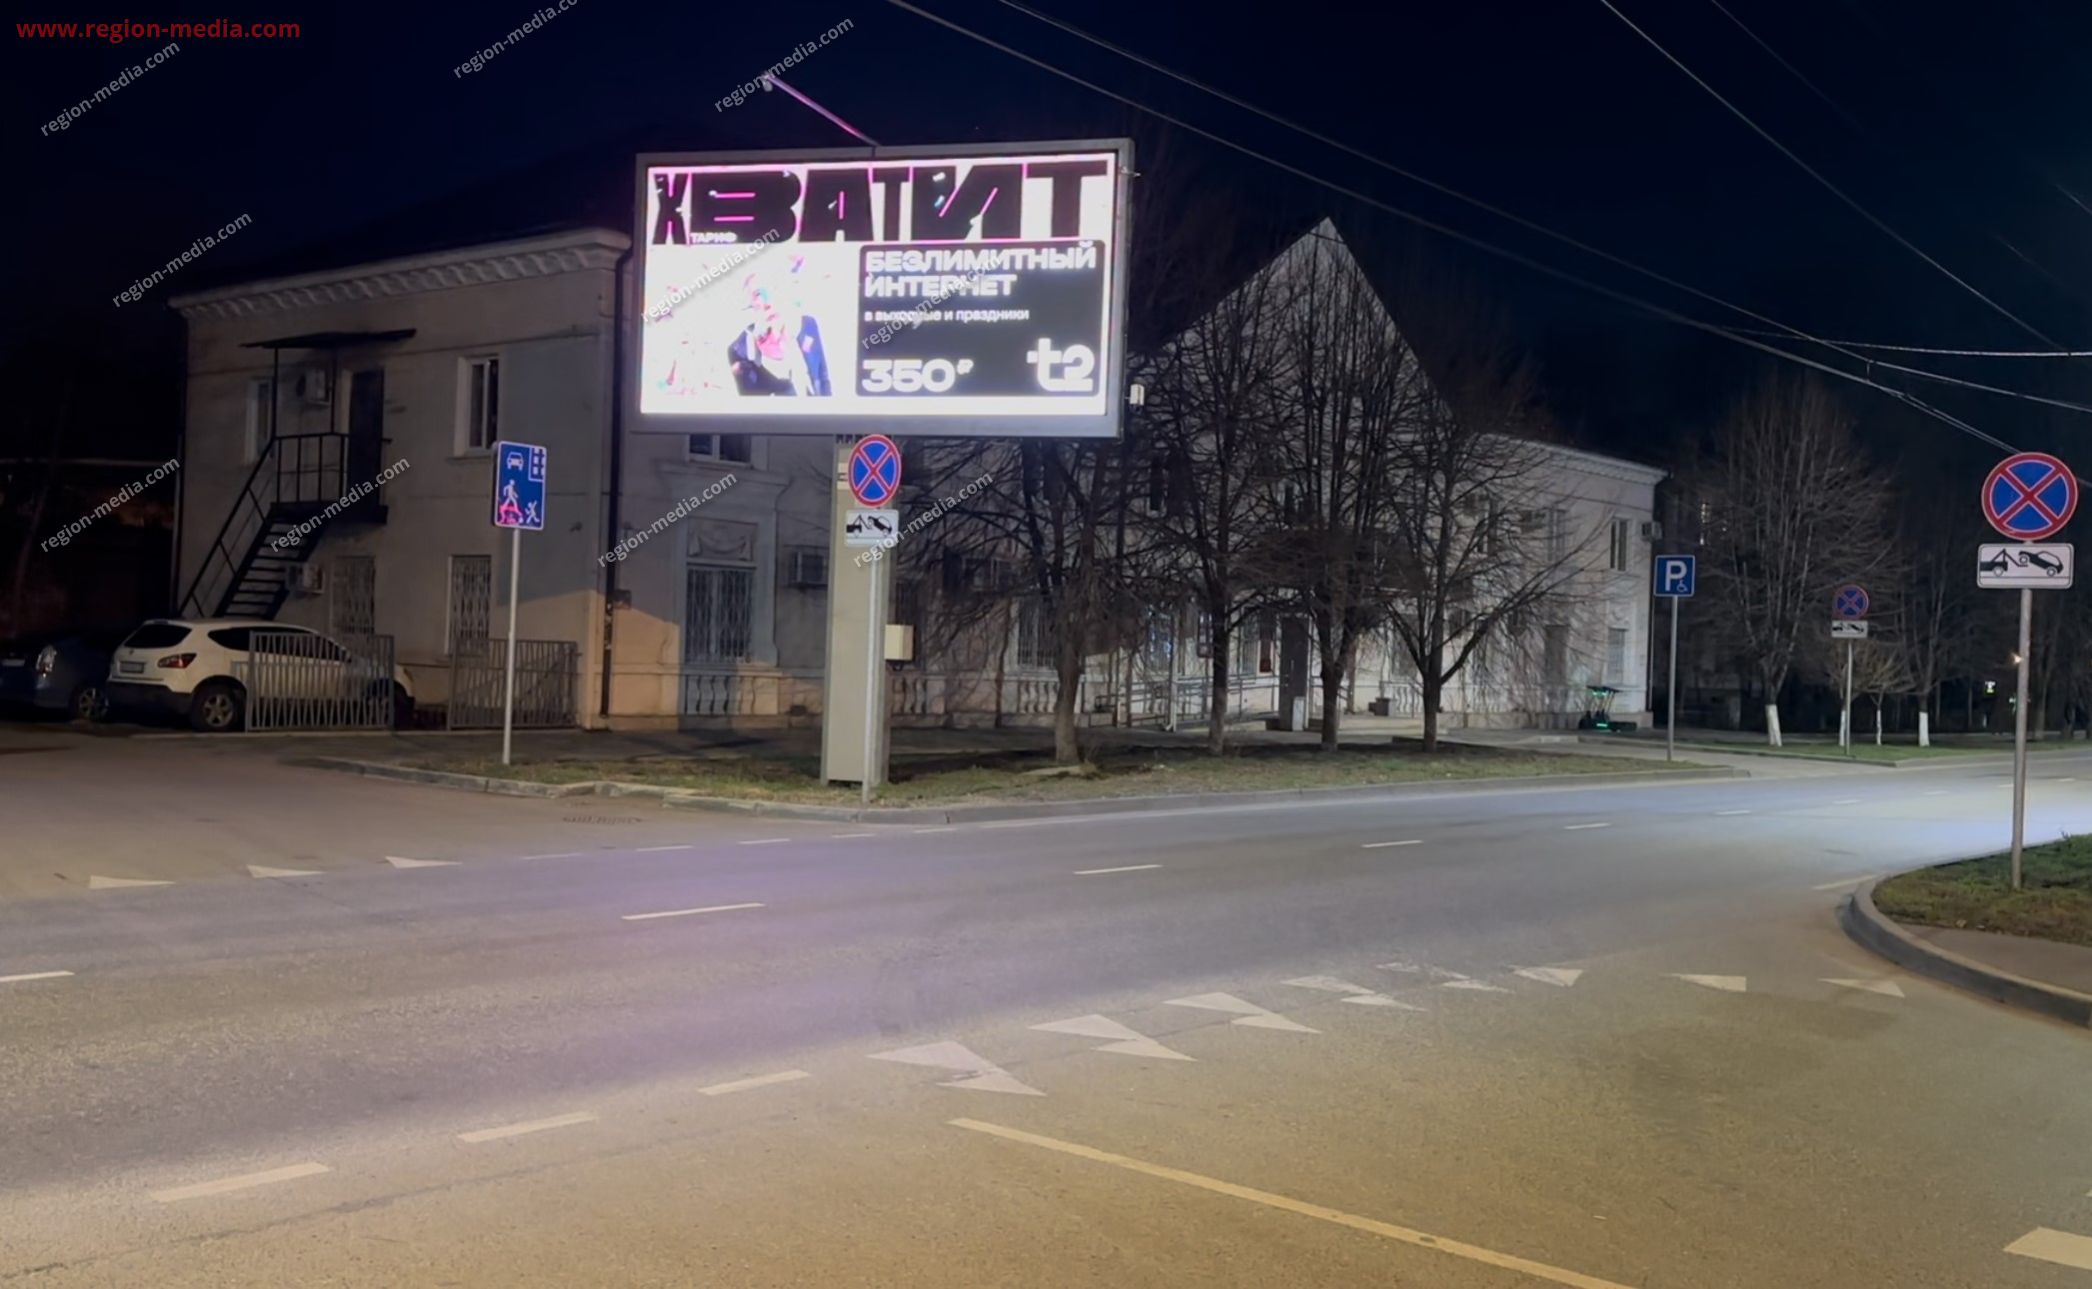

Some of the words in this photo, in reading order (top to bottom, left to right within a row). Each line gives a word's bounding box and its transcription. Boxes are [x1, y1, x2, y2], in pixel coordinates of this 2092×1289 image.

[652, 160, 1107, 245] ХВАТИТ
[865, 240, 1097, 273] БЕЗЛИМИТНЫЙ
[864, 273, 1017, 298] ИНТЕРНЕТ
[944, 310, 953, 321] и
[956, 309, 1030, 323] праздники
[1026, 337, 1095, 392] t2
[1665, 560, 1687, 591] P
